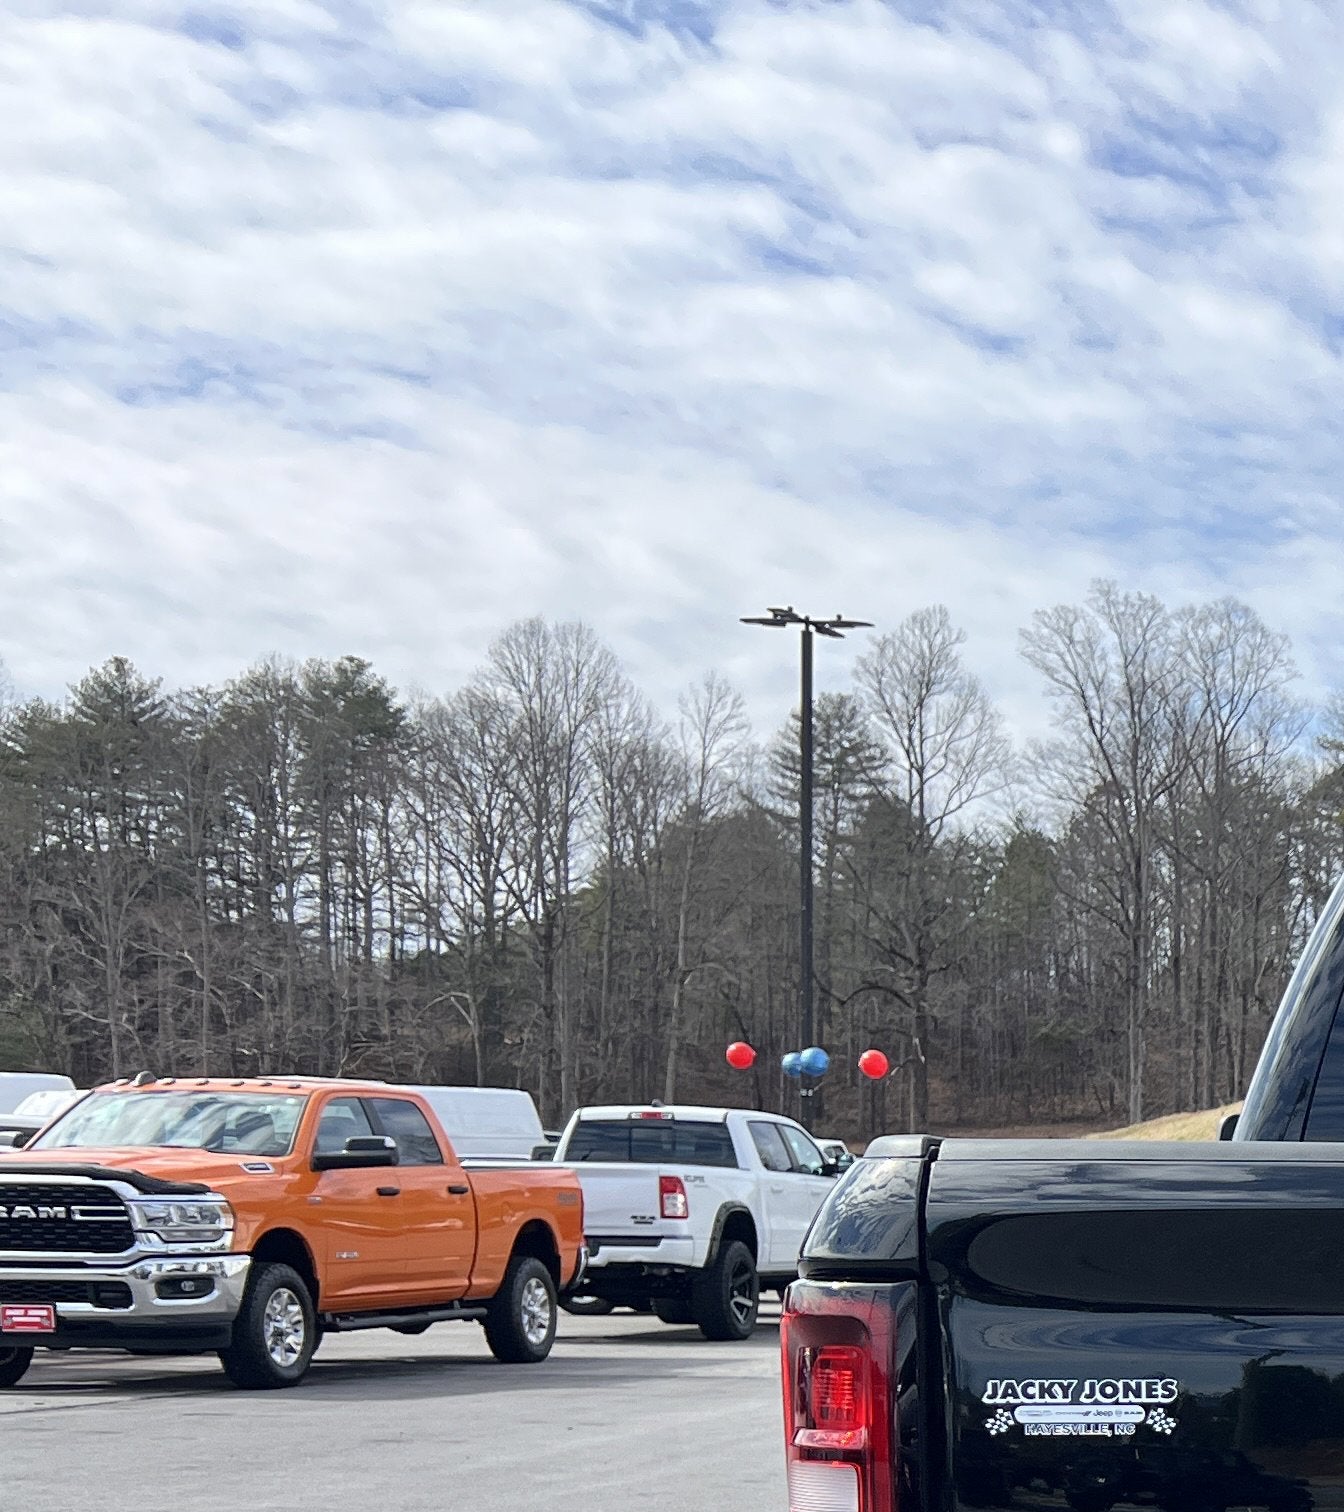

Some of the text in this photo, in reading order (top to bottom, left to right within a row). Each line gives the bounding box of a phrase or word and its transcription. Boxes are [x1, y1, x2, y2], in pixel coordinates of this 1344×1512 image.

[983, 1379, 1178, 1404] JACKY JONES
[1024, 1423, 1136, 1437] HAYESVILLE, NC
